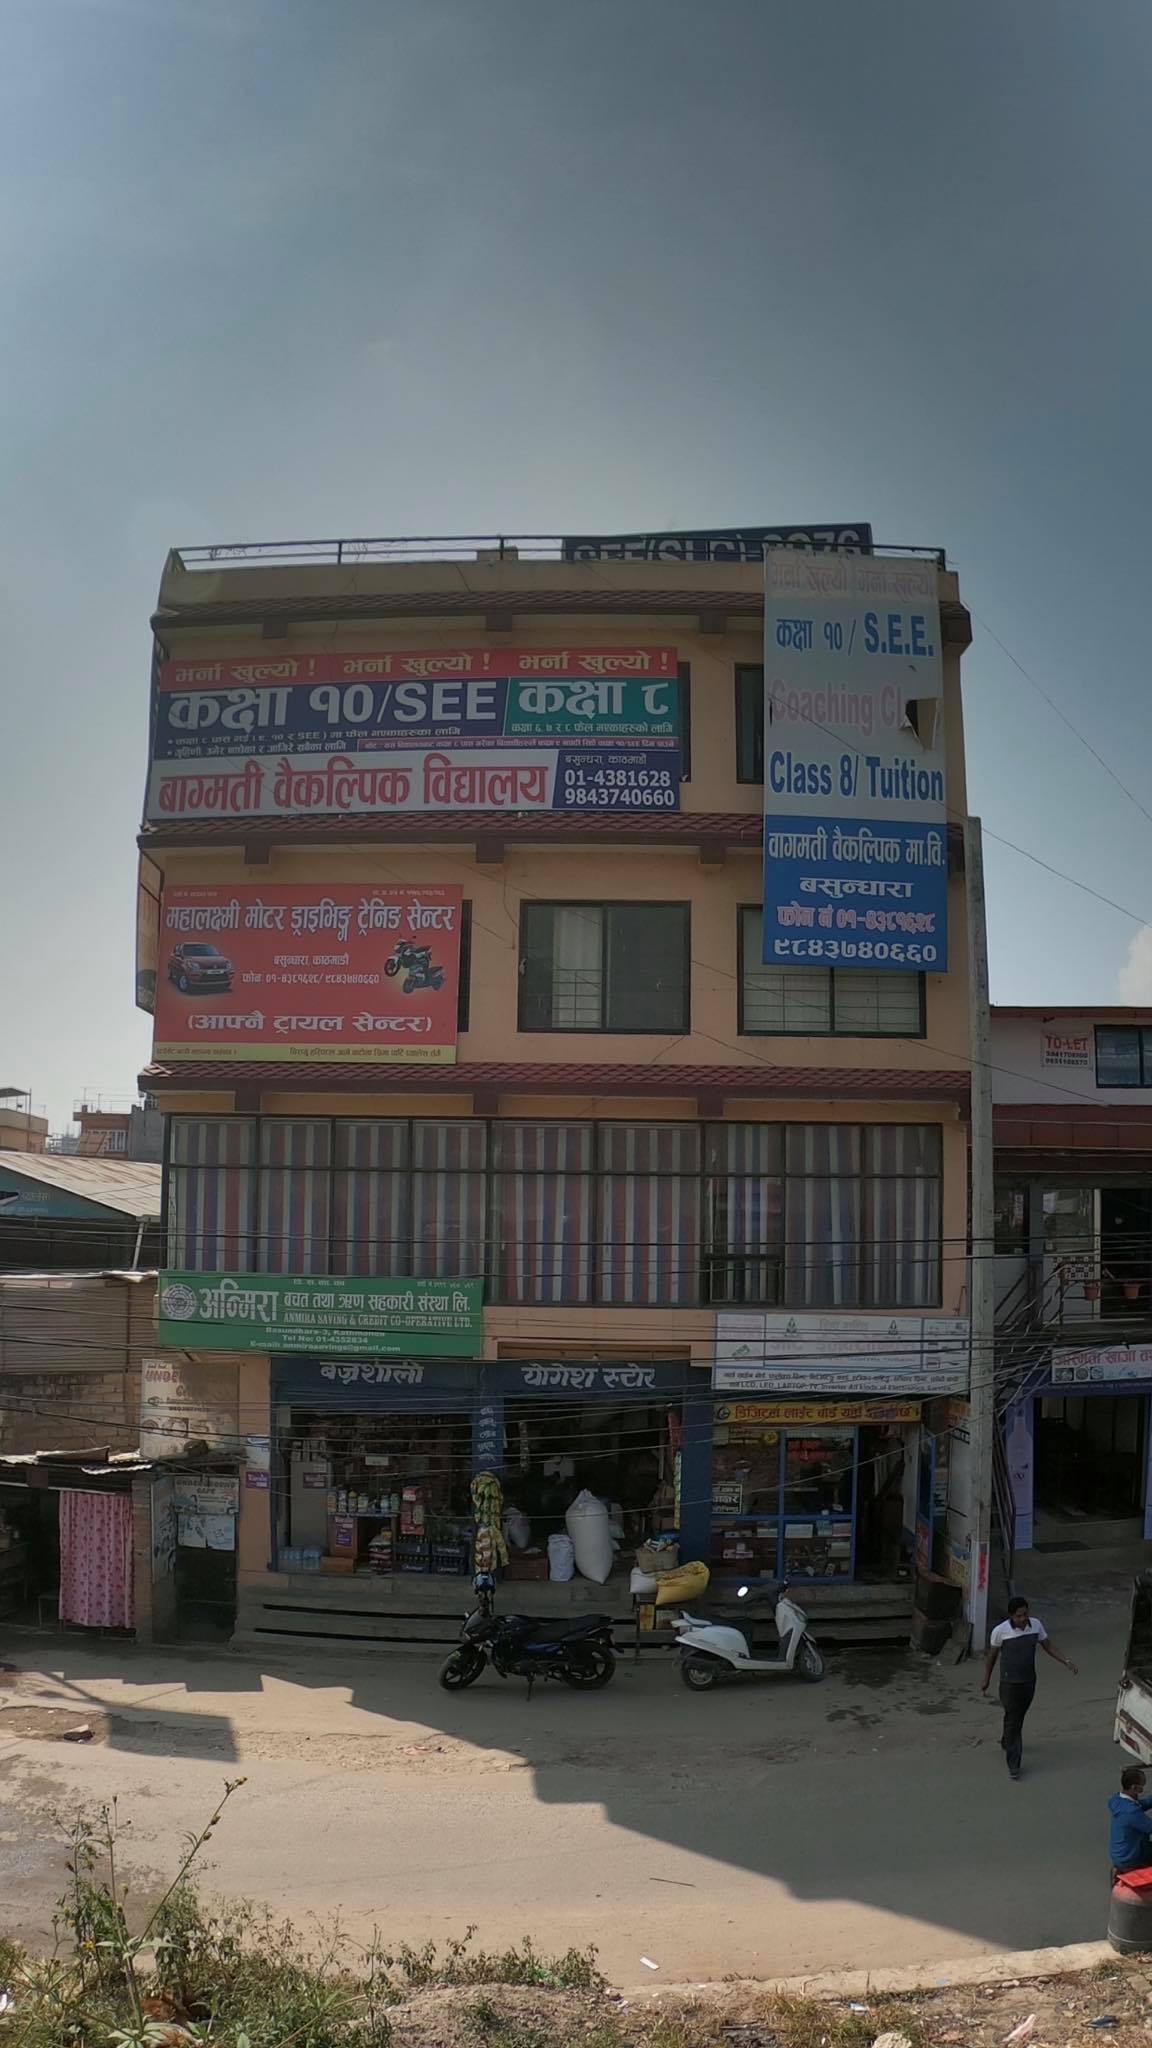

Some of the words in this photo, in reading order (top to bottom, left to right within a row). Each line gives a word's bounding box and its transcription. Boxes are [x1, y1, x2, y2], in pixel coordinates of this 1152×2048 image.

[776, 618, 814, 652] कक्षा
[824, 621, 843, 651] १०
[864, 612, 934, 657] S.E.E.
[175, 662, 224, 682] भर्ना
[230, 657, 299, 683] खुल्यो
[344, 655, 393, 674] भर्ना
[400, 652, 473, 677] खुल्यो
[519, 651, 570, 671] भर्ना
[578, 650, 652, 674] खुल्यो
[168, 687, 293, 733] कक्षा
[518, 681, 627, 720] कक्षा
[641, 682, 669, 716] ८
[771, 678, 873, 736] Coaching
[273, 756, 412, 810] वैकल्पिक
[422, 752, 548, 806] विद्यालय
[564, 769, 671, 788] 01-4381628
[770, 750, 832, 796] Class
[840, 754, 859, 797] 8/
[865, 756, 943, 801] Tuition
[564, 788, 675, 806] 9843740660
[800, 877, 914, 899] बसुन्धारा
[166, 898, 241, 932] महालक्ष्मी
[245, 897, 288, 930] मोटर
[406, 897, 456, 931] सेन्टर
[777, 901, 815, 929] फोन
[774, 938, 937, 964] ९८४३७४०६६०
[272, 1014, 345, 1035] ट्रायल
[312, 1292, 335, 1309] तथा
[368, 1290, 414, 1312] सहकारी
[417, 1291, 450, 1312] संस्था
[521, 1362, 599, 1390] योगेश
[601, 1362, 656, 1390] स्टोर
